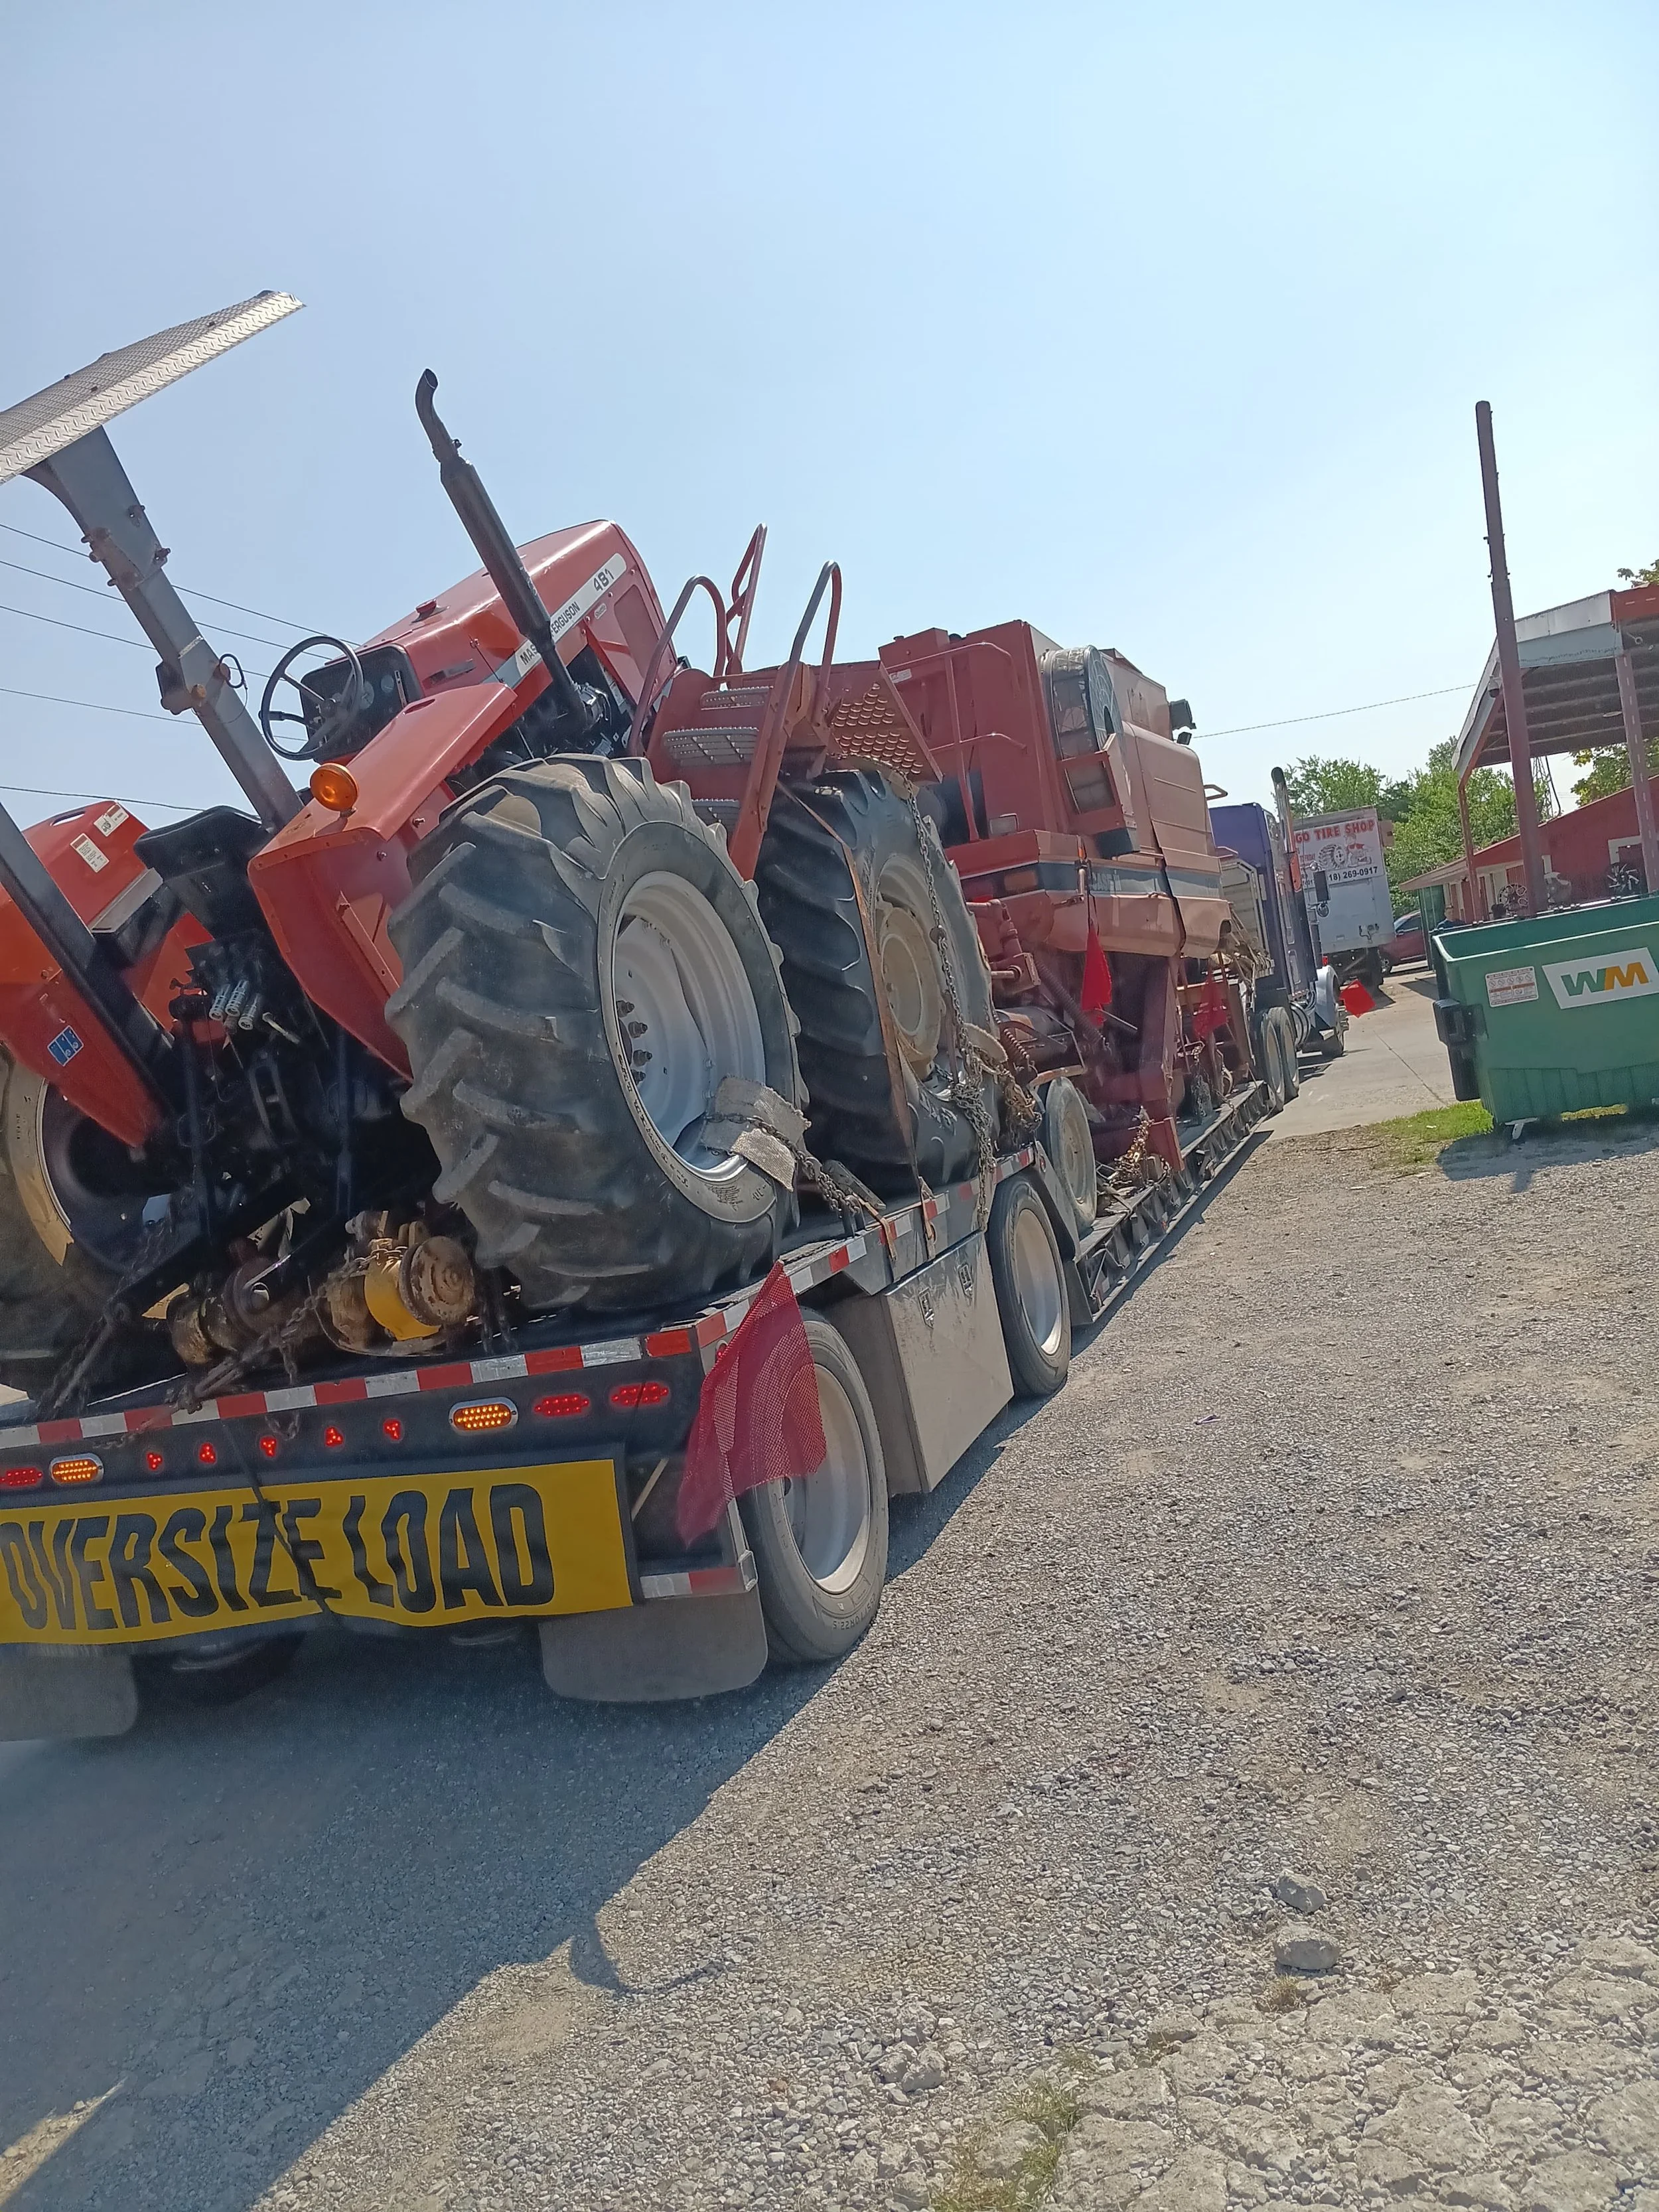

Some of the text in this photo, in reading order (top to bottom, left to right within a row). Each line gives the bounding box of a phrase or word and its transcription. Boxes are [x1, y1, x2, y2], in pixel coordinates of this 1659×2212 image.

[520, 644, 538, 665] MAS
[593, 568, 614, 591] 481
[1296, 819, 1375, 843] GO TIRE SHOP
[1329, 867, 1378, 881] 18) 269-0917
[1561, 962, 1649, 996] WM
[0, 1483, 555, 1631] OVERSIZE LOAD
